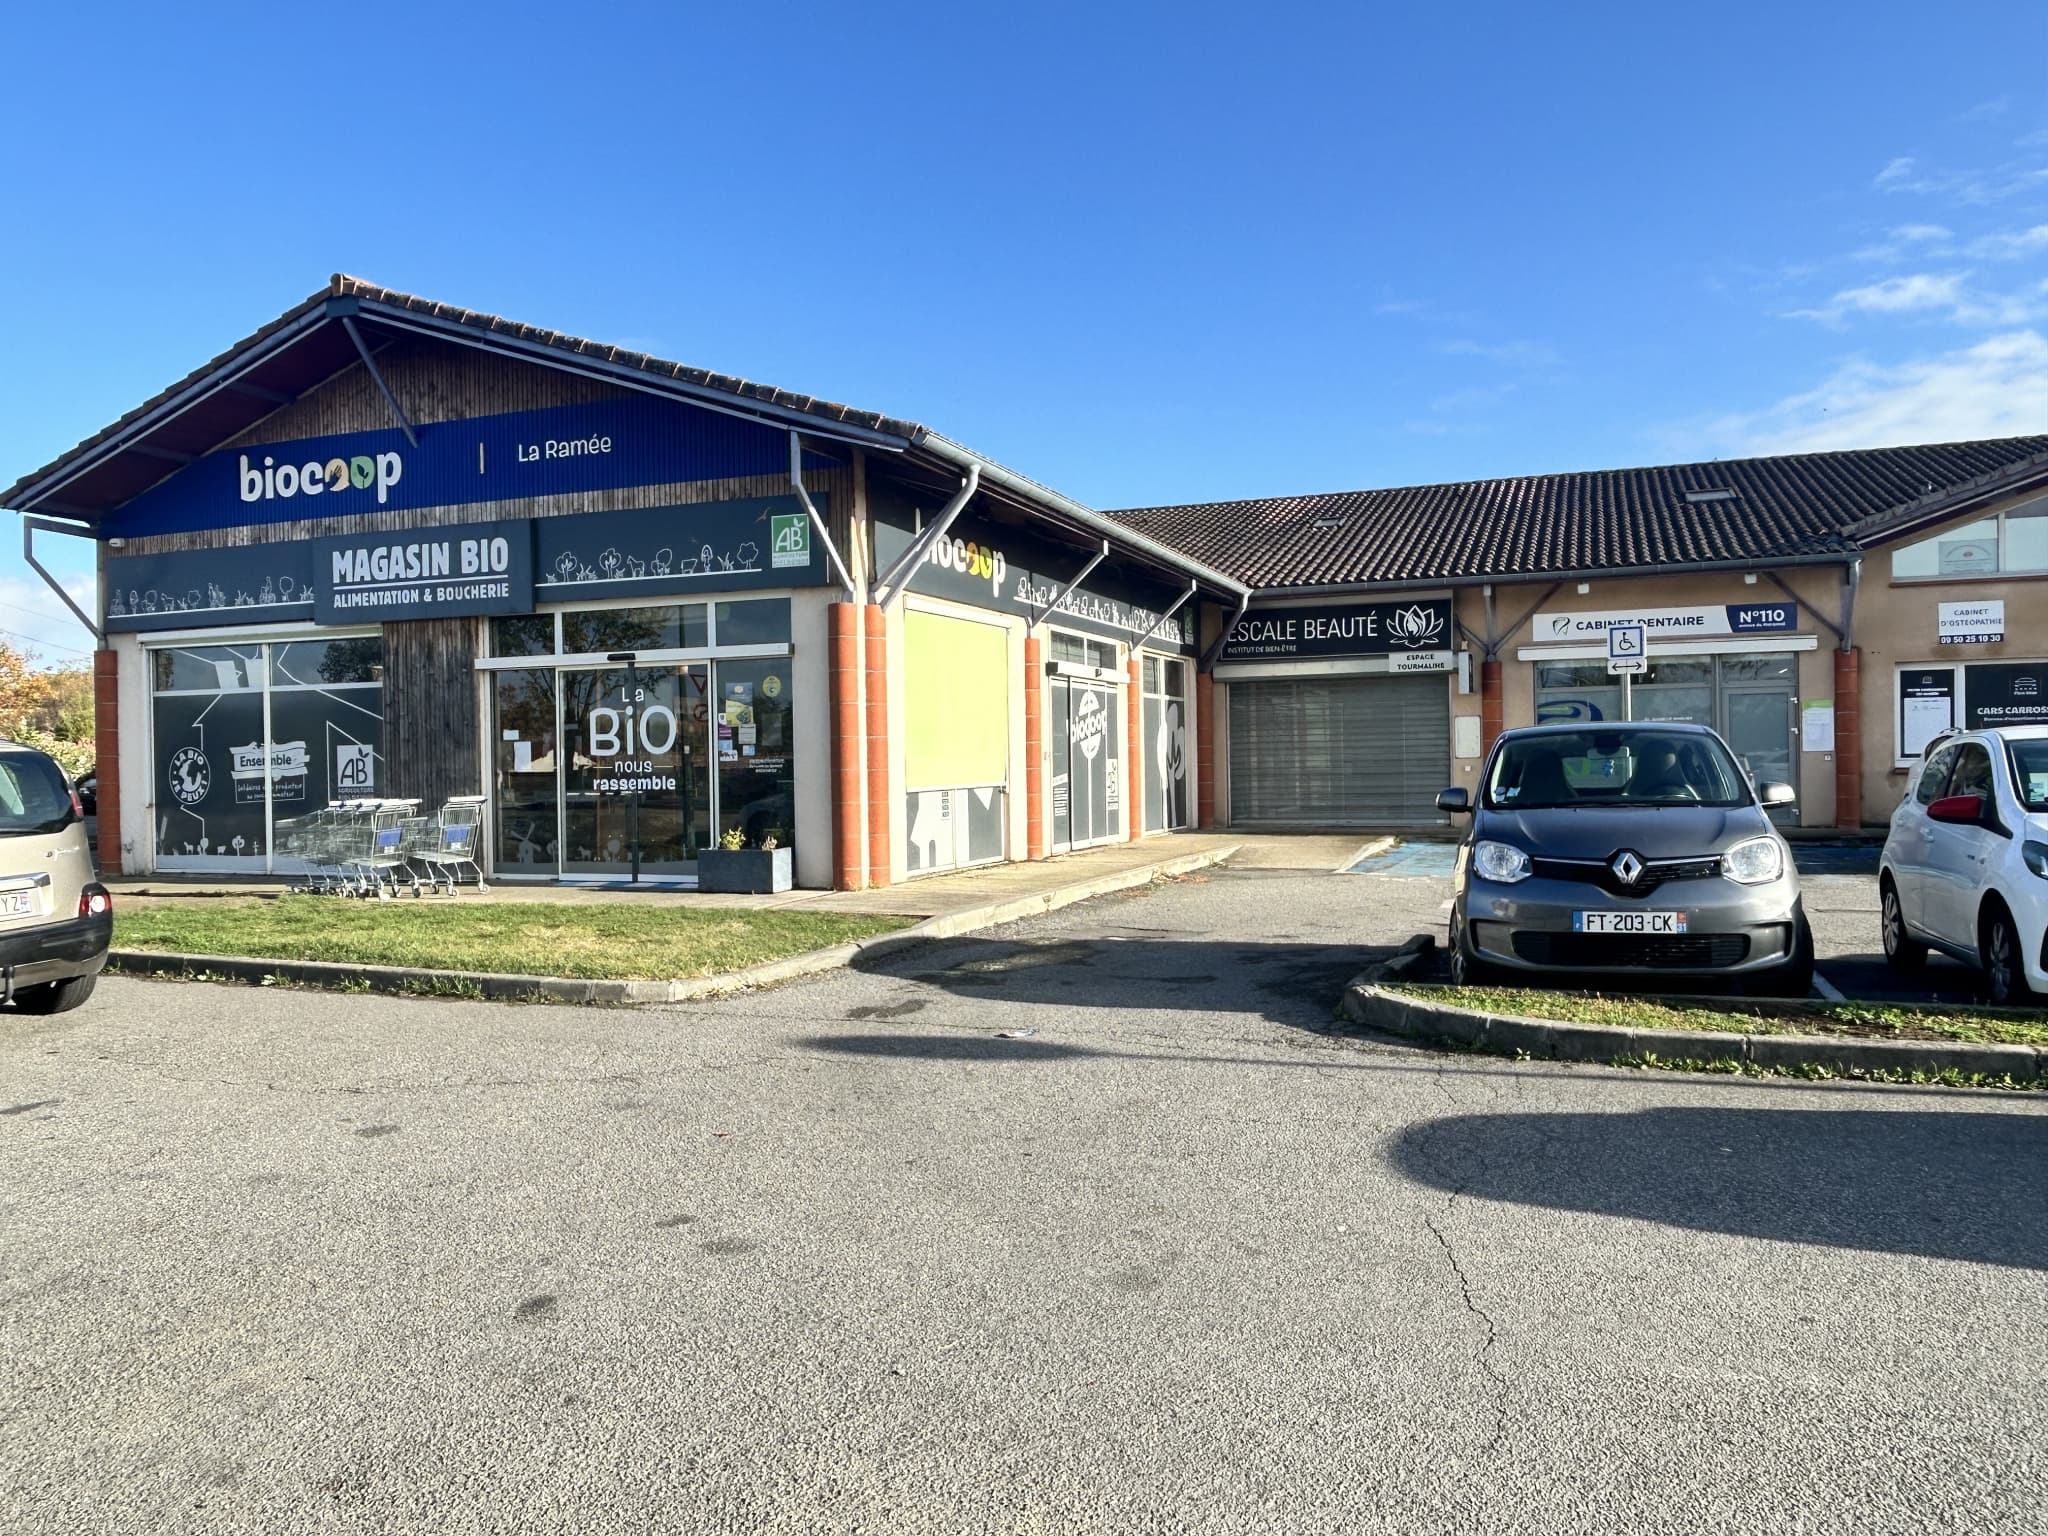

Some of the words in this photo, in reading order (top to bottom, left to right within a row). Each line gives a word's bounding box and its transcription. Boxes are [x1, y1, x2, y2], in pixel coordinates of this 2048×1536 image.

[518, 443, 539, 462] La
[546, 434, 612, 458] Ramée
[240, 451, 402, 504] biocoop
[776, 527, 803, 551] AB
[332, 542, 450, 584] MAGASIN
[460, 537, 509, 574] BIO
[333, 588, 419, 609] ALIMENTATION
[423, 589, 433, 602] &
[437, 583, 509, 602] BOUCHERIE
[1740, 609, 1785, 623] N°110
[1953, 608, 1989, 616] CABINET
[1227, 620, 1297, 642] ESCALE
[1304, 610, 1378, 639] BEAUTÉ
[1965, 635, 1976, 643] 25
[1406, 653, 1435, 661] ESPACE
[1397, 662, 1445, 670] TOURMALINE
[622, 687, 645, 702] La
[1977, 707, 2004, 715] CARS
[174, 752, 186, 767] LA
[187, 750, 204, 765] BIO
[614, 760, 653, 773] nous
[340, 758, 368, 785] AB
[593, 775, 676, 790] rassemble
[180, 785, 205, 802] PEUX
[1587, 914, 1672, 931] FT-203-CK
